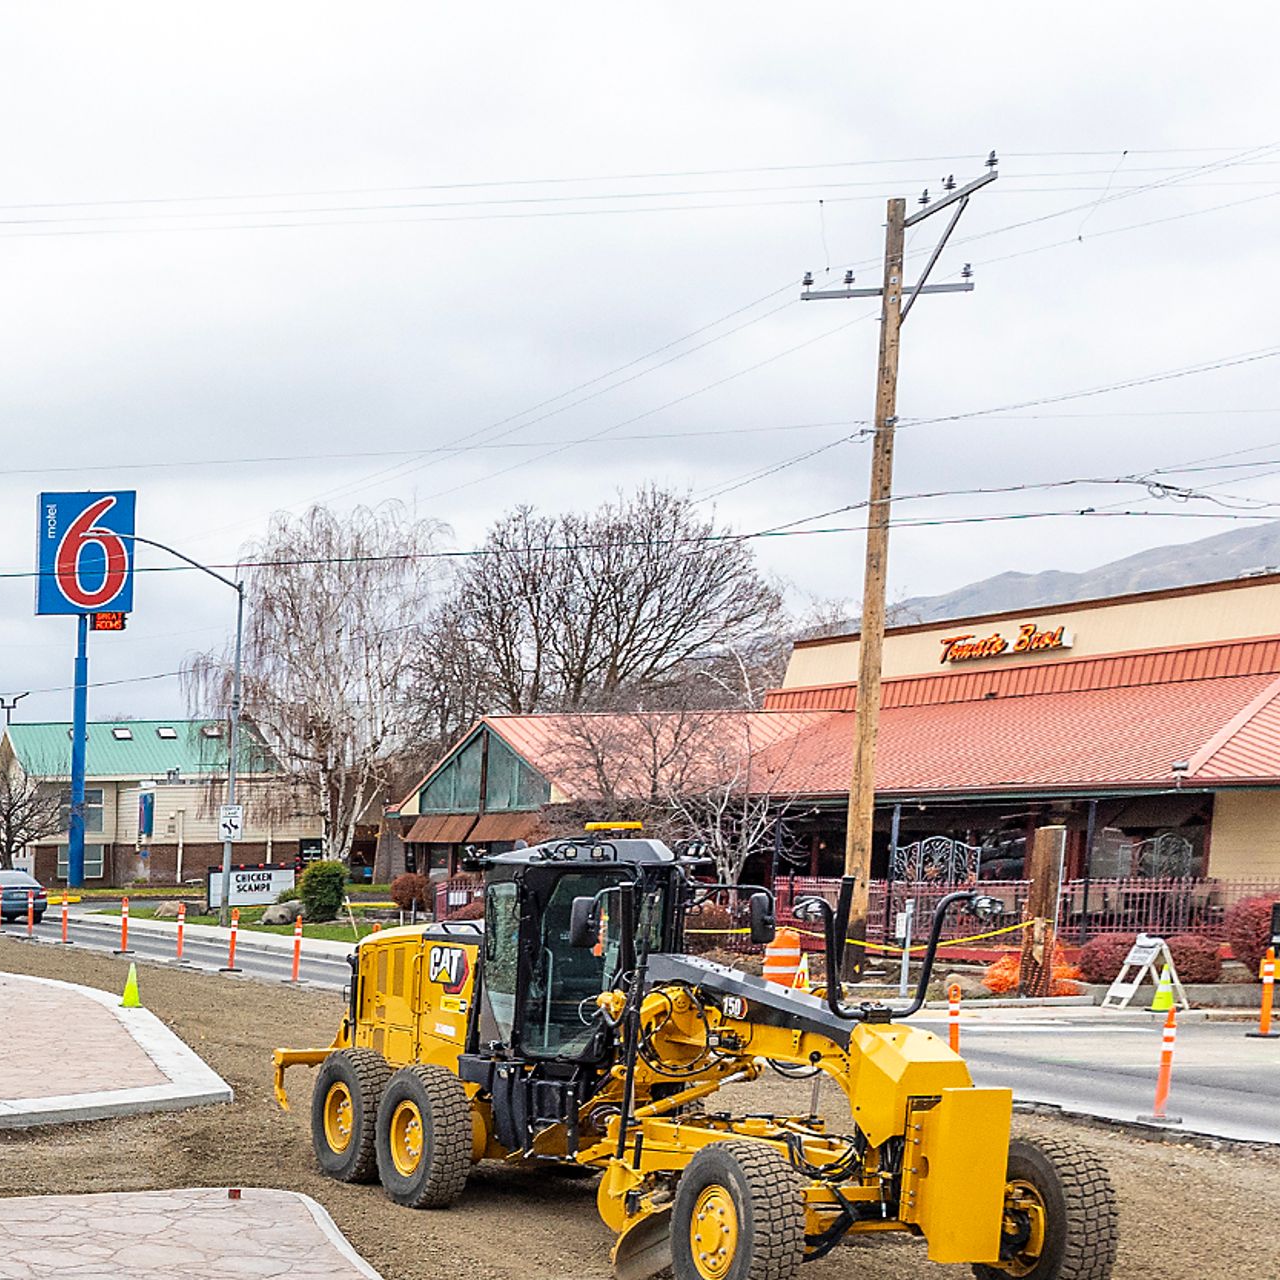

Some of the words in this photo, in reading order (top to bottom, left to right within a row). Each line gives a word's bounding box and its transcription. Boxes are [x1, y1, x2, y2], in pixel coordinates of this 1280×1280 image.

[46, 503, 58, 539] motel
[95, 621, 123, 629] ROOMS
[940, 633, 1008, 664] Tomato
[235, 873, 272, 883] CHICKEN
[236, 883, 271, 893] SCAMPI
[429, 946, 463, 984] CAT
[722, 996, 742, 1017] 150
